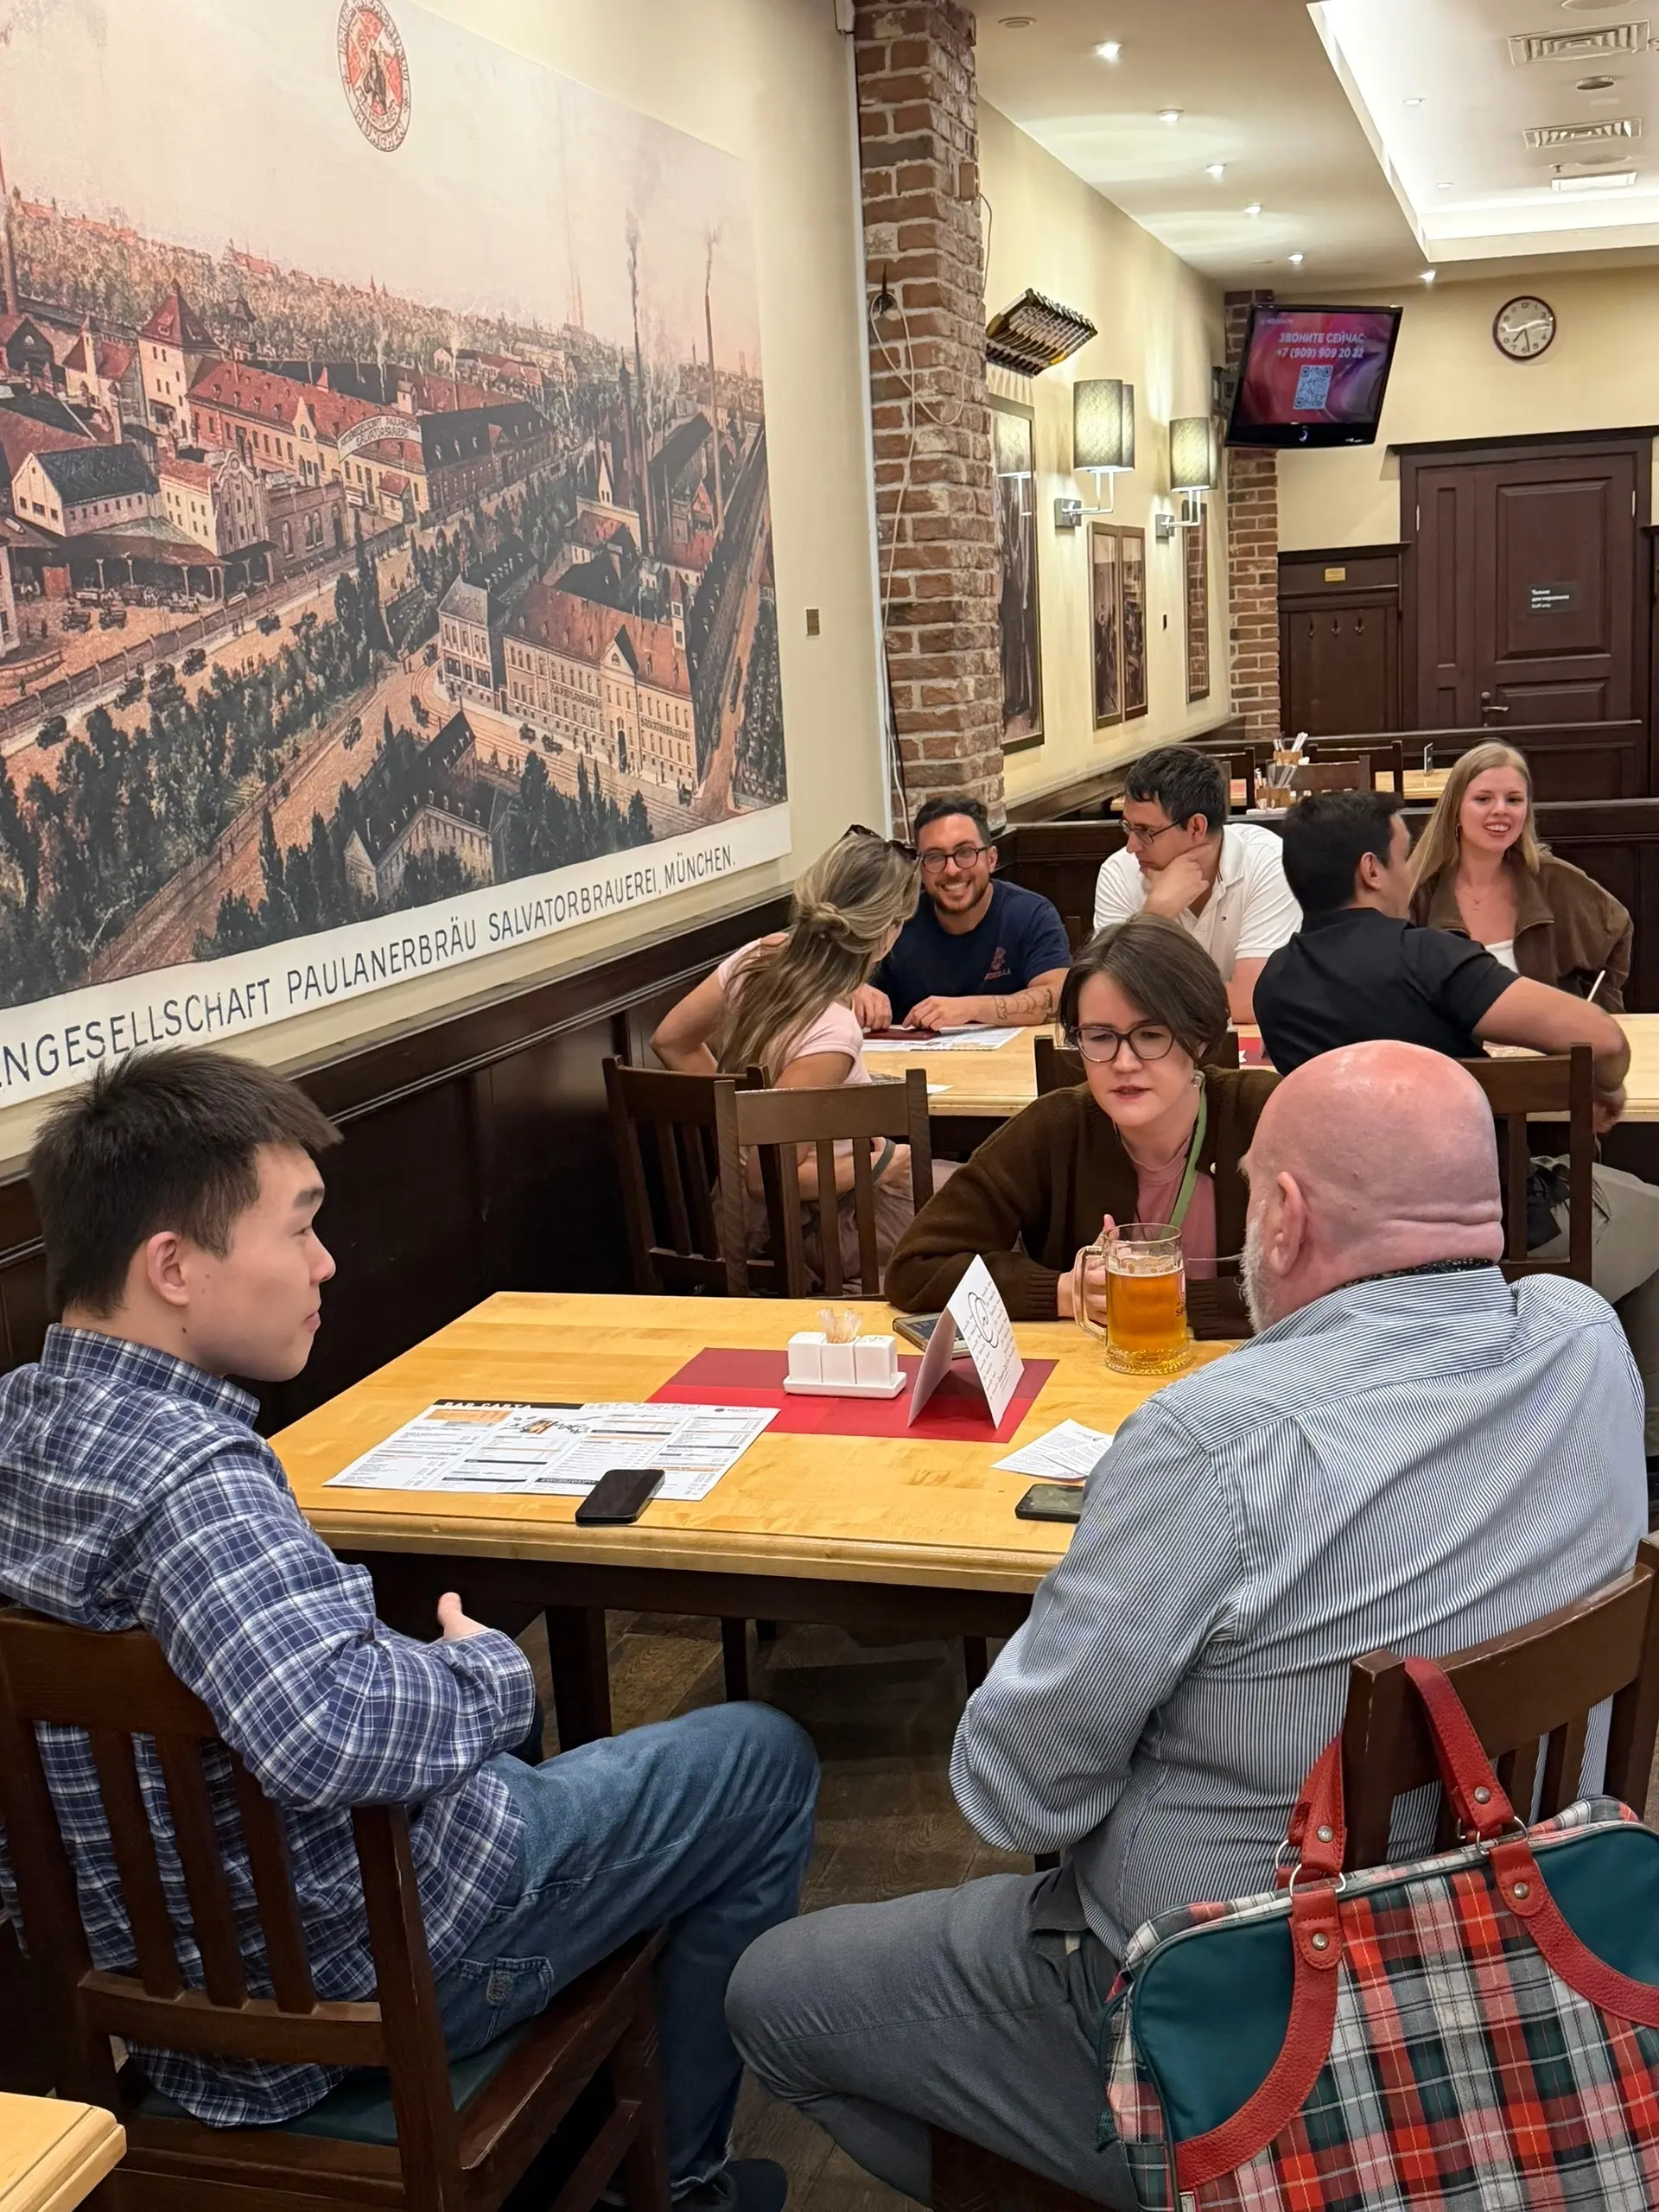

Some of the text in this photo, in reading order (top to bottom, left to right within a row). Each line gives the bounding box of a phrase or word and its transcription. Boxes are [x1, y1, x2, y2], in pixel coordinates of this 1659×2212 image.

[1279, 331, 1365, 343] ЗВОНИТЕ СЕЙЧАС
[0, 844, 735, 1087] NGESELLSCHAFT PAULANERBRÄU SALVATORBRAUEREI, MÜNCHEN.
